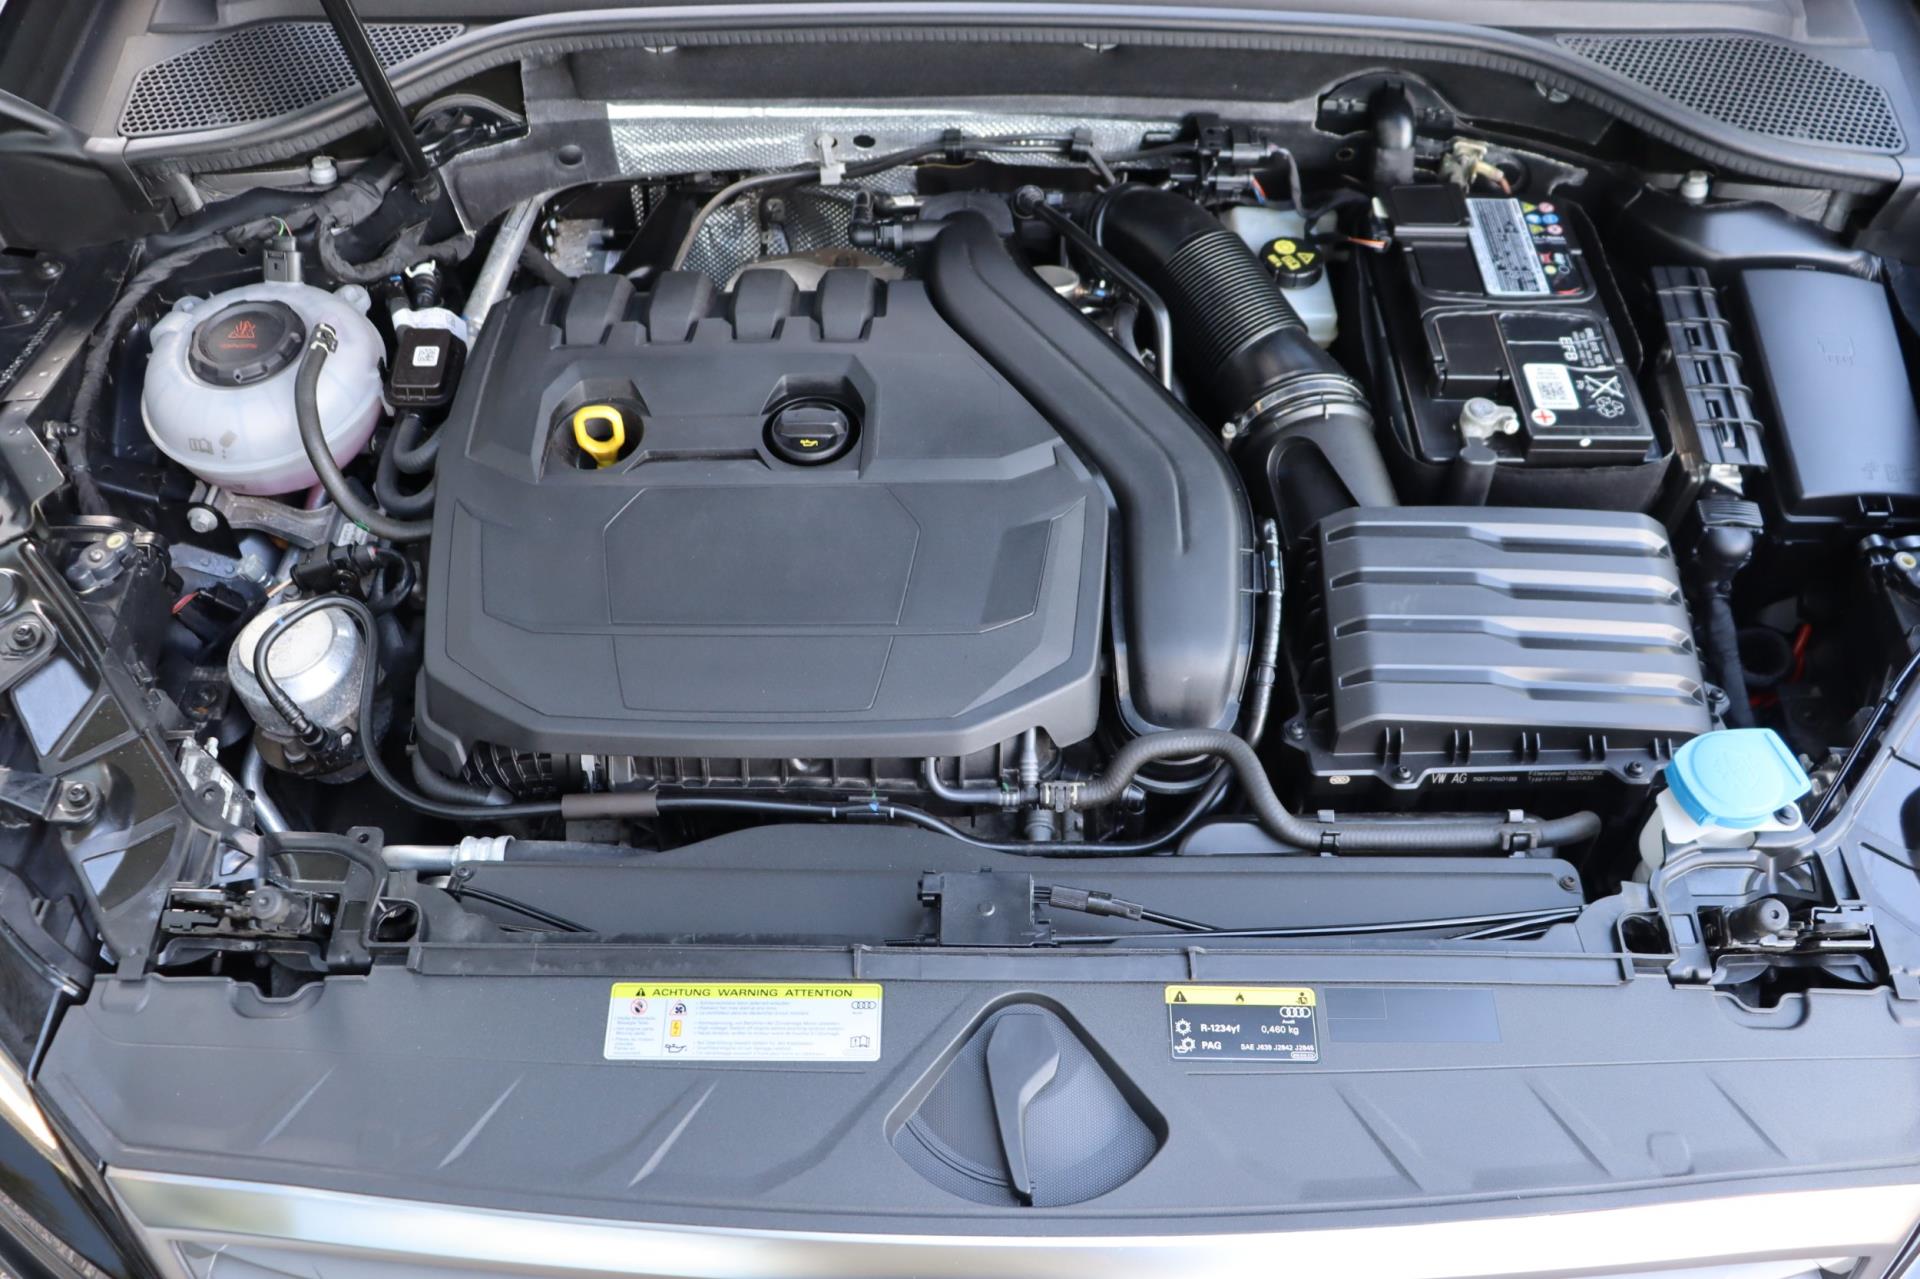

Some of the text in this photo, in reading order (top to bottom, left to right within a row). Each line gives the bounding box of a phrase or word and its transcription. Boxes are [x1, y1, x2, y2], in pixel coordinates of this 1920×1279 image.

[1558, 336, 1579, 361] EFB
[1432, 773, 1447, 784] VW
[1451, 772, 1468, 784] AG
[652, 988, 853, 997] ACHTUNG WARNING ATTENTION
[1200, 1024, 1240, 1034] R-1234yf
[1288, 1025, 1299, 1035] kg
[1202, 1041, 1222, 1050] PAG
